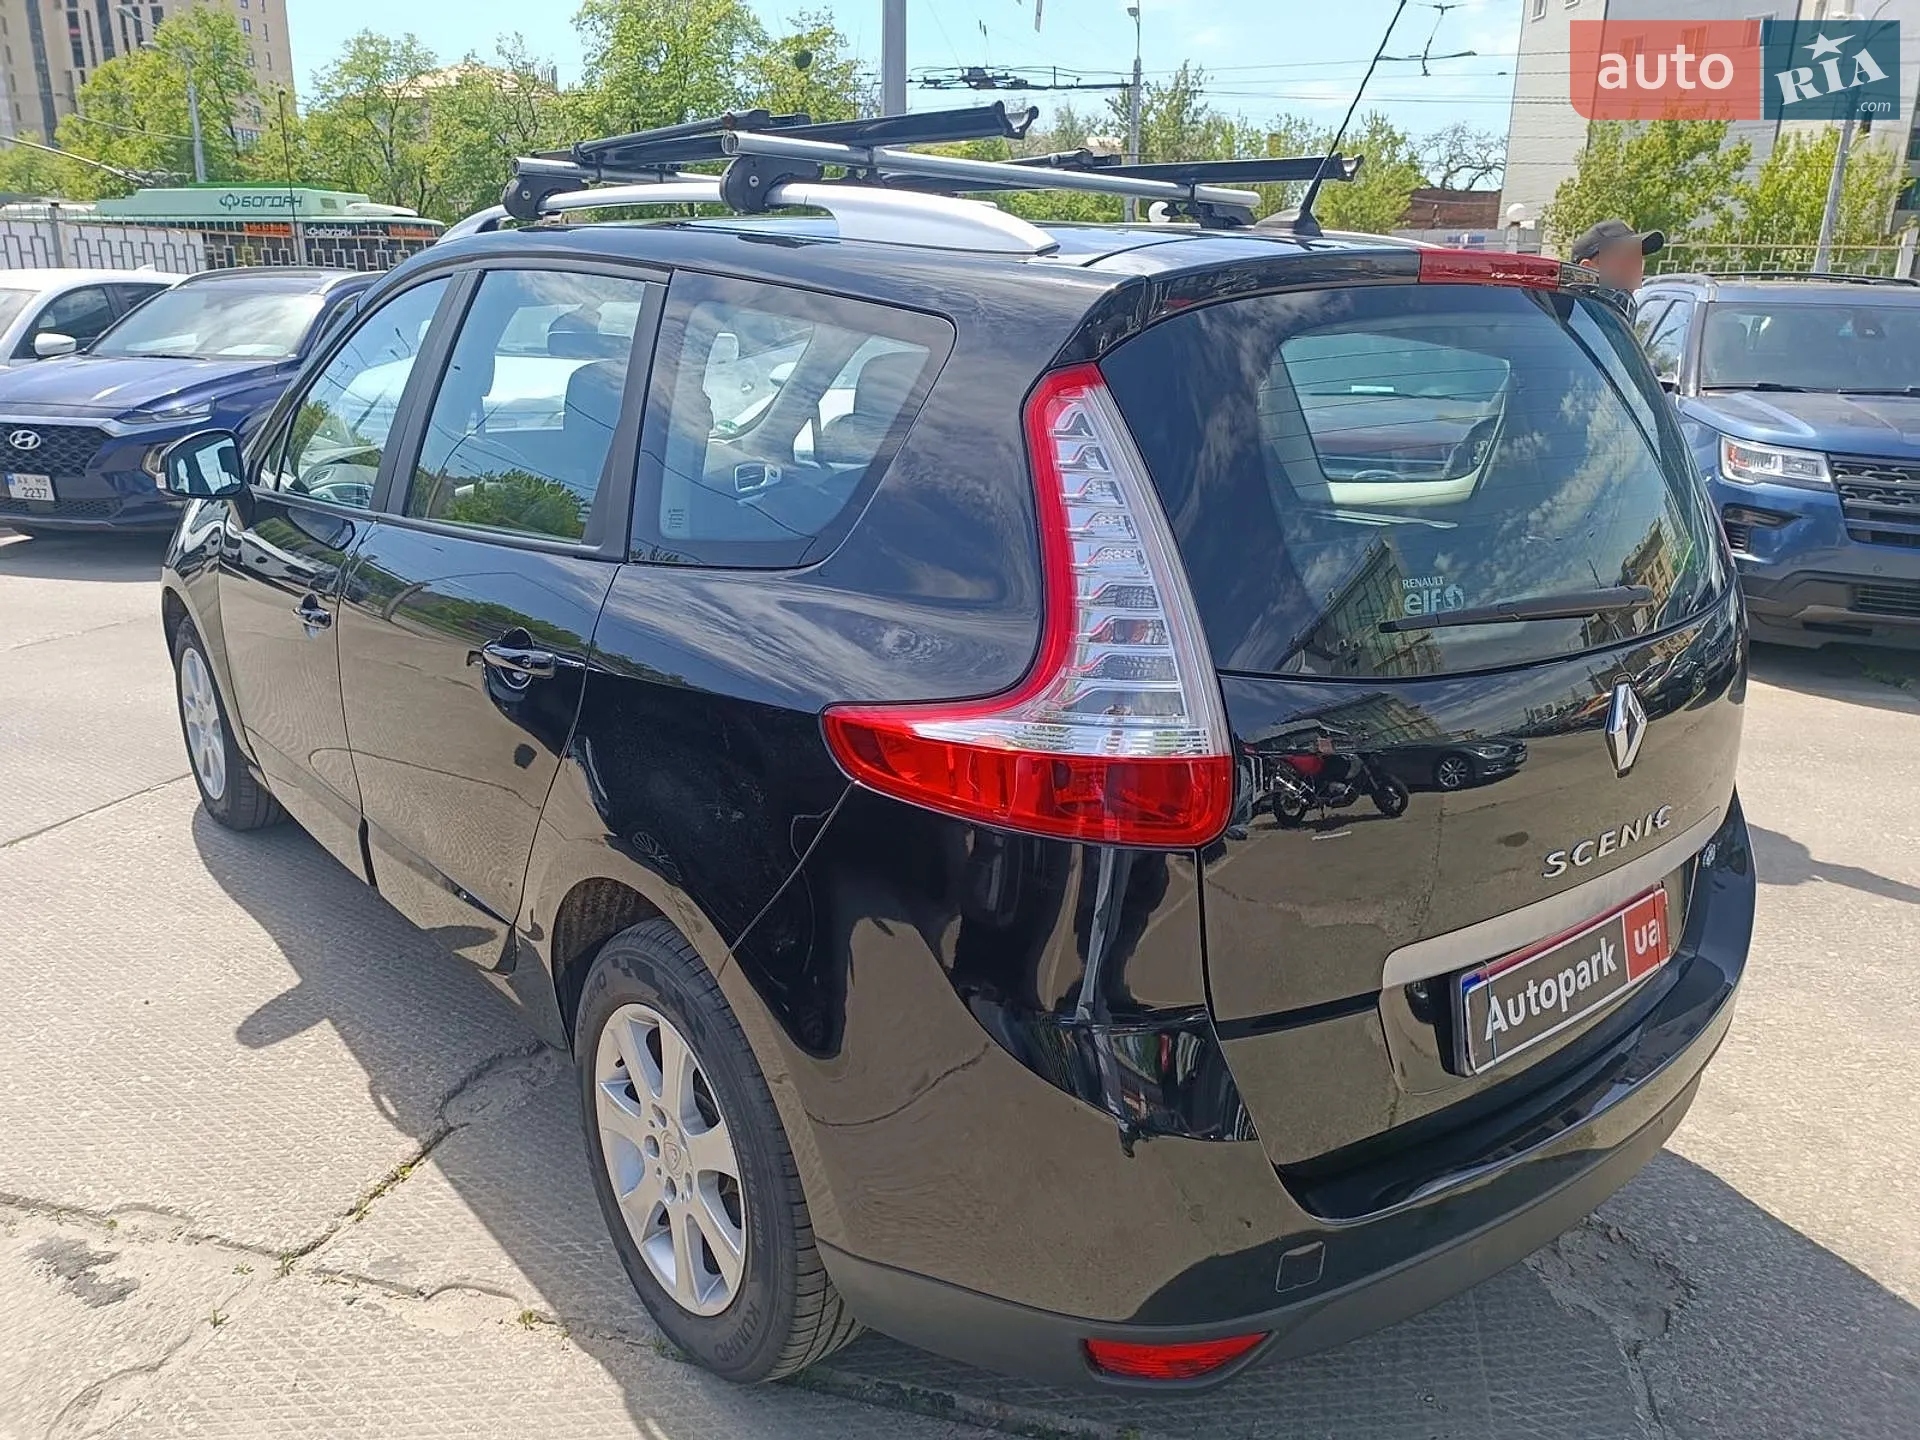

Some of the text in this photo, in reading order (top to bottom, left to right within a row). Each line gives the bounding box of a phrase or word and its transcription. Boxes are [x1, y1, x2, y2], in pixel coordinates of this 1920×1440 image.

[241, 195, 302, 208] БОГДАН
[1402, 576, 1444, 589] RENAULT
[1404, 588, 1441, 615] elf
[1542, 804, 1672, 878] SCENIC
[1484, 918, 1660, 1041] Autopark ua
